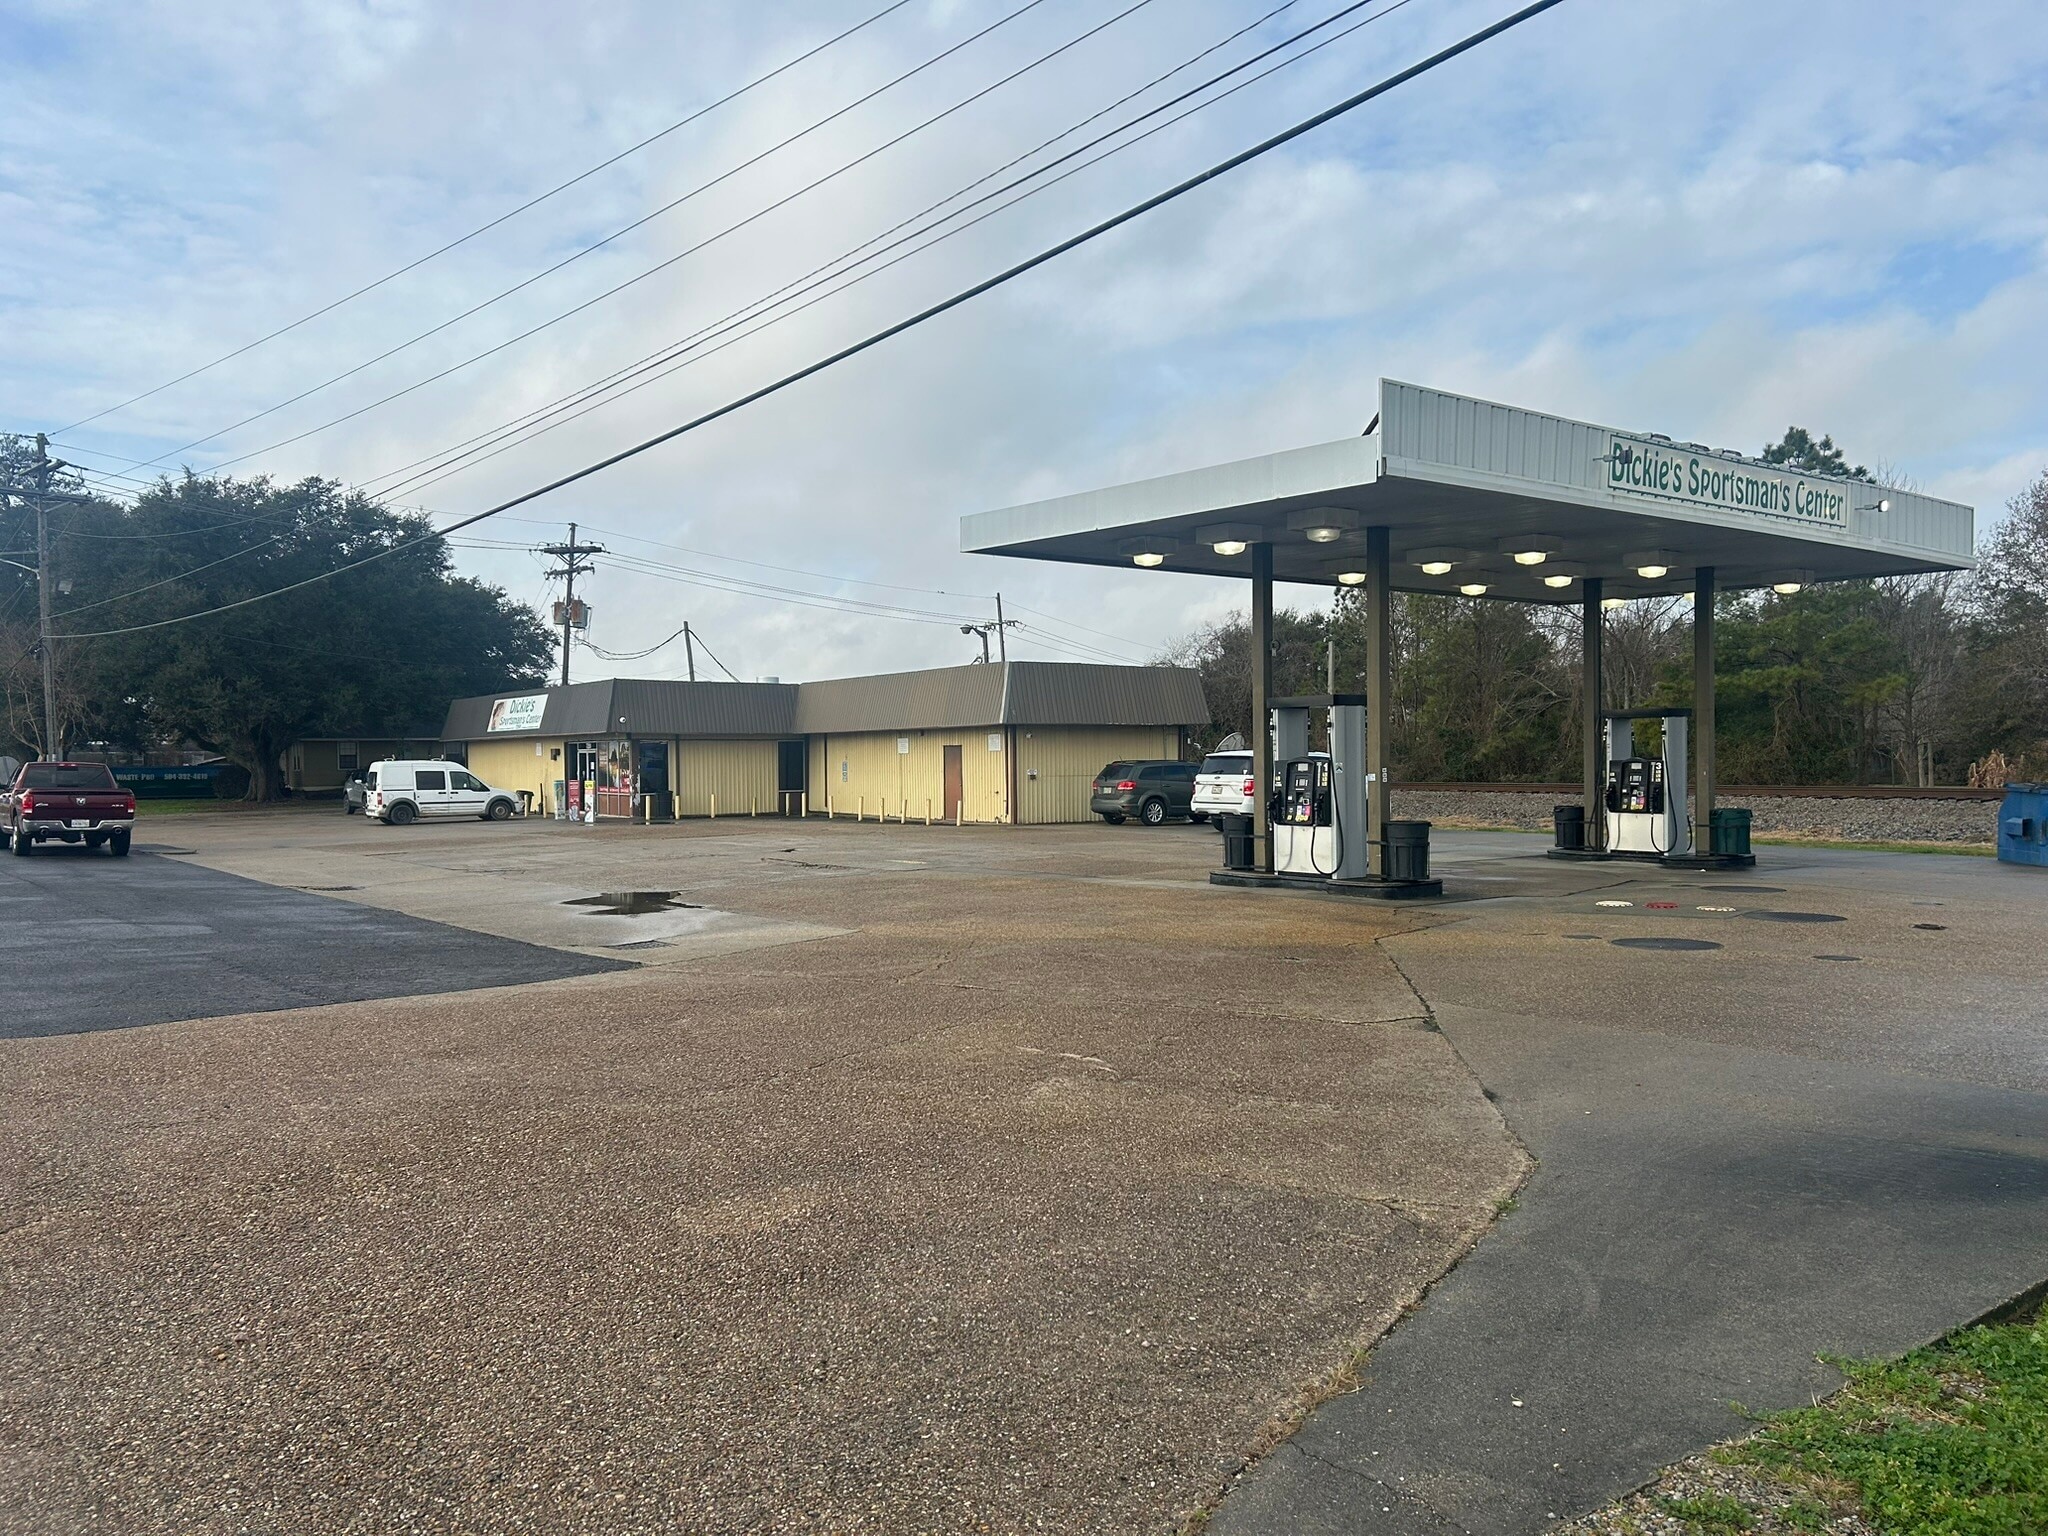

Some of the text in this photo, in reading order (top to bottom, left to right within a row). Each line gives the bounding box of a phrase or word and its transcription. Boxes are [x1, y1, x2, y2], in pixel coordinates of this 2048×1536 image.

[1611, 442, 1844, 521] Dickie's Sportsman's Center
[509, 698, 536, 714] Dickie's
[1655, 762, 1662, 770] 3
[115, 773, 139, 781] WASTE
